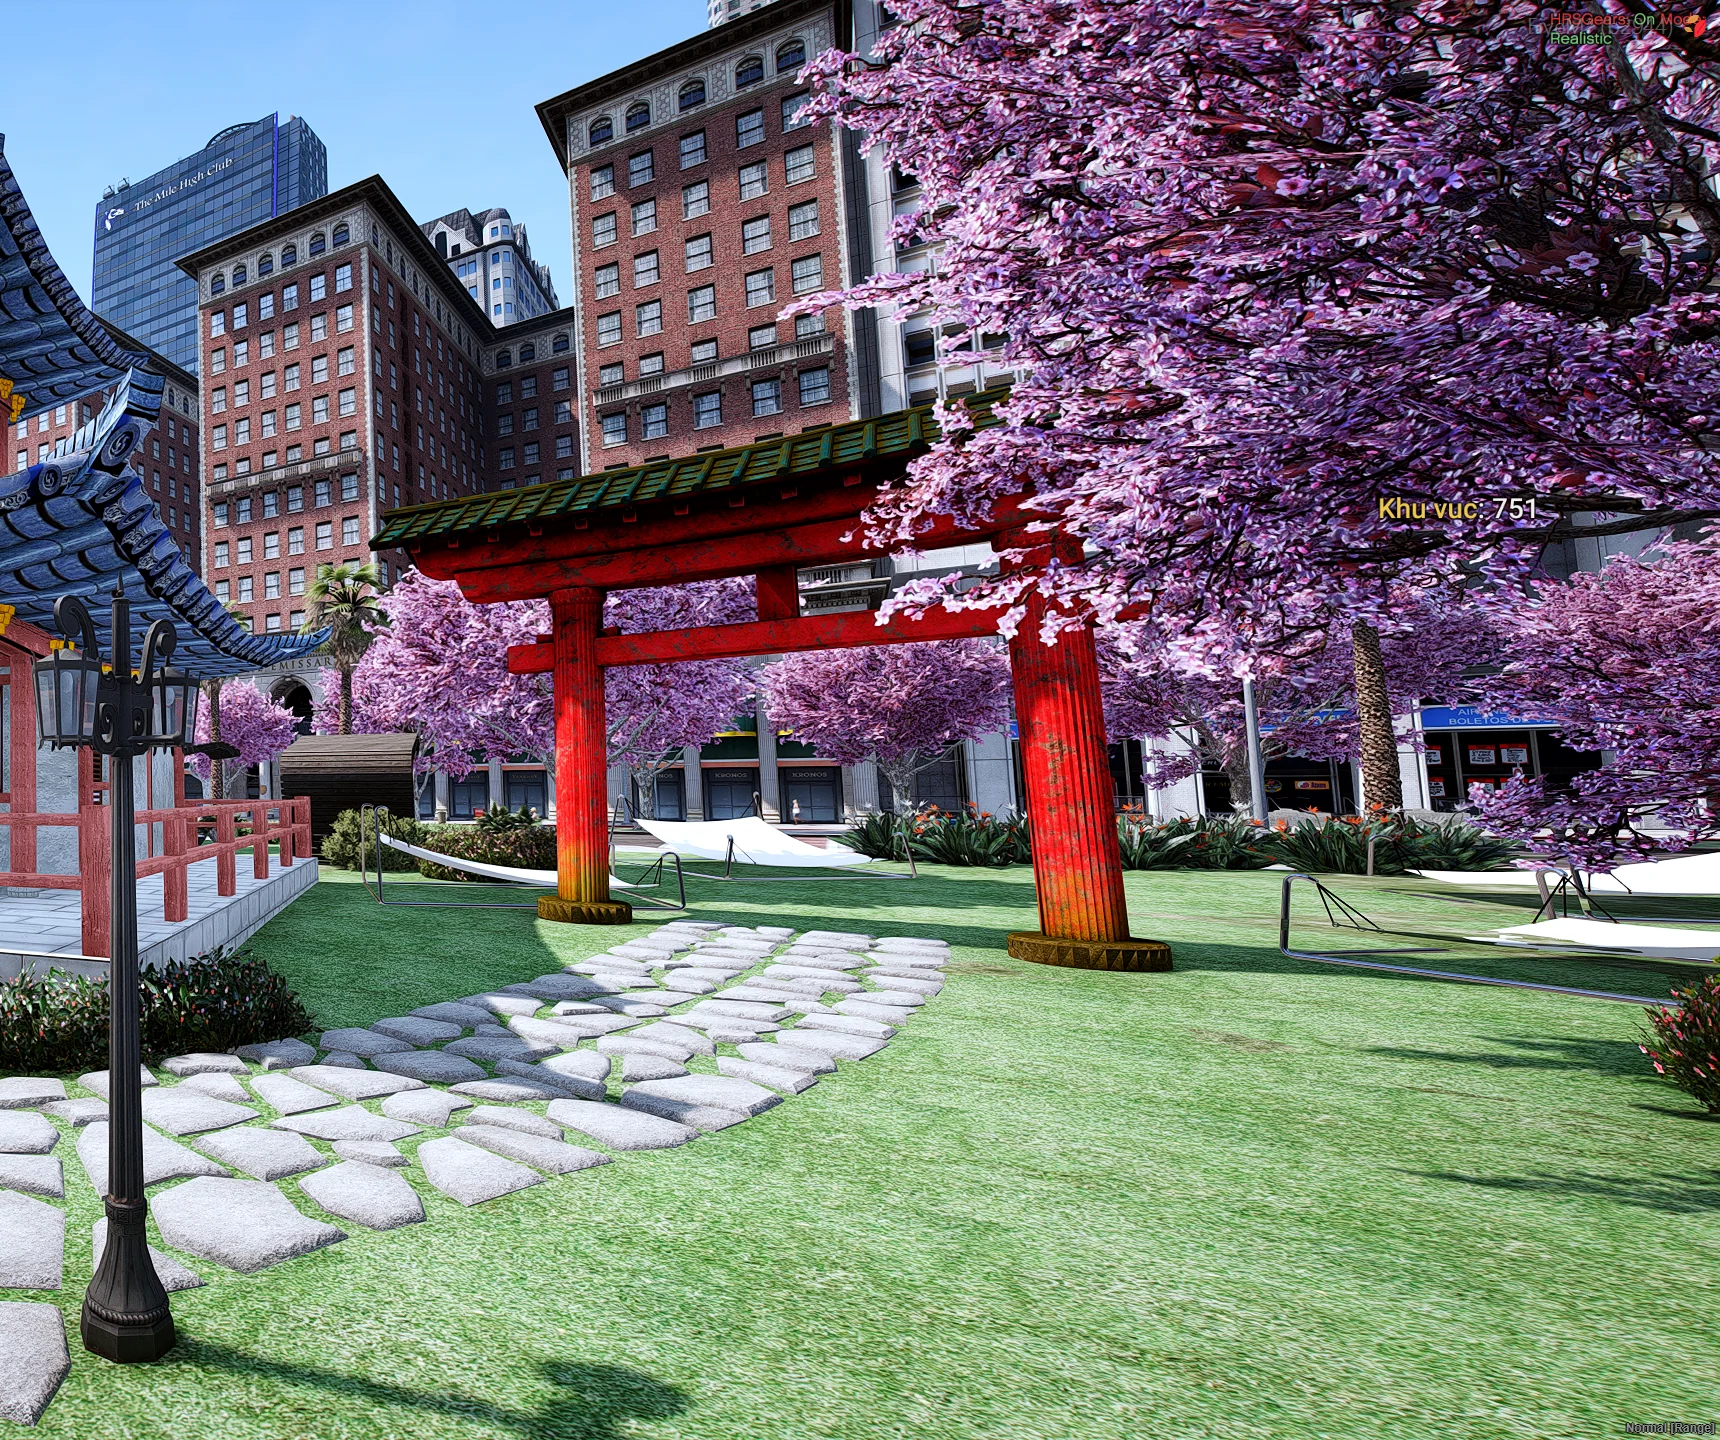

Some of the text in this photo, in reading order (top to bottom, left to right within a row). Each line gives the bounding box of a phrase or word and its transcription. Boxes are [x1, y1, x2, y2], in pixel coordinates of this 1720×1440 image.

[134, 157, 234, 211] The Mile High Club
[271, 656, 333, 672] EMISSAR
[1448, 716, 1508, 725] BOLETOS
